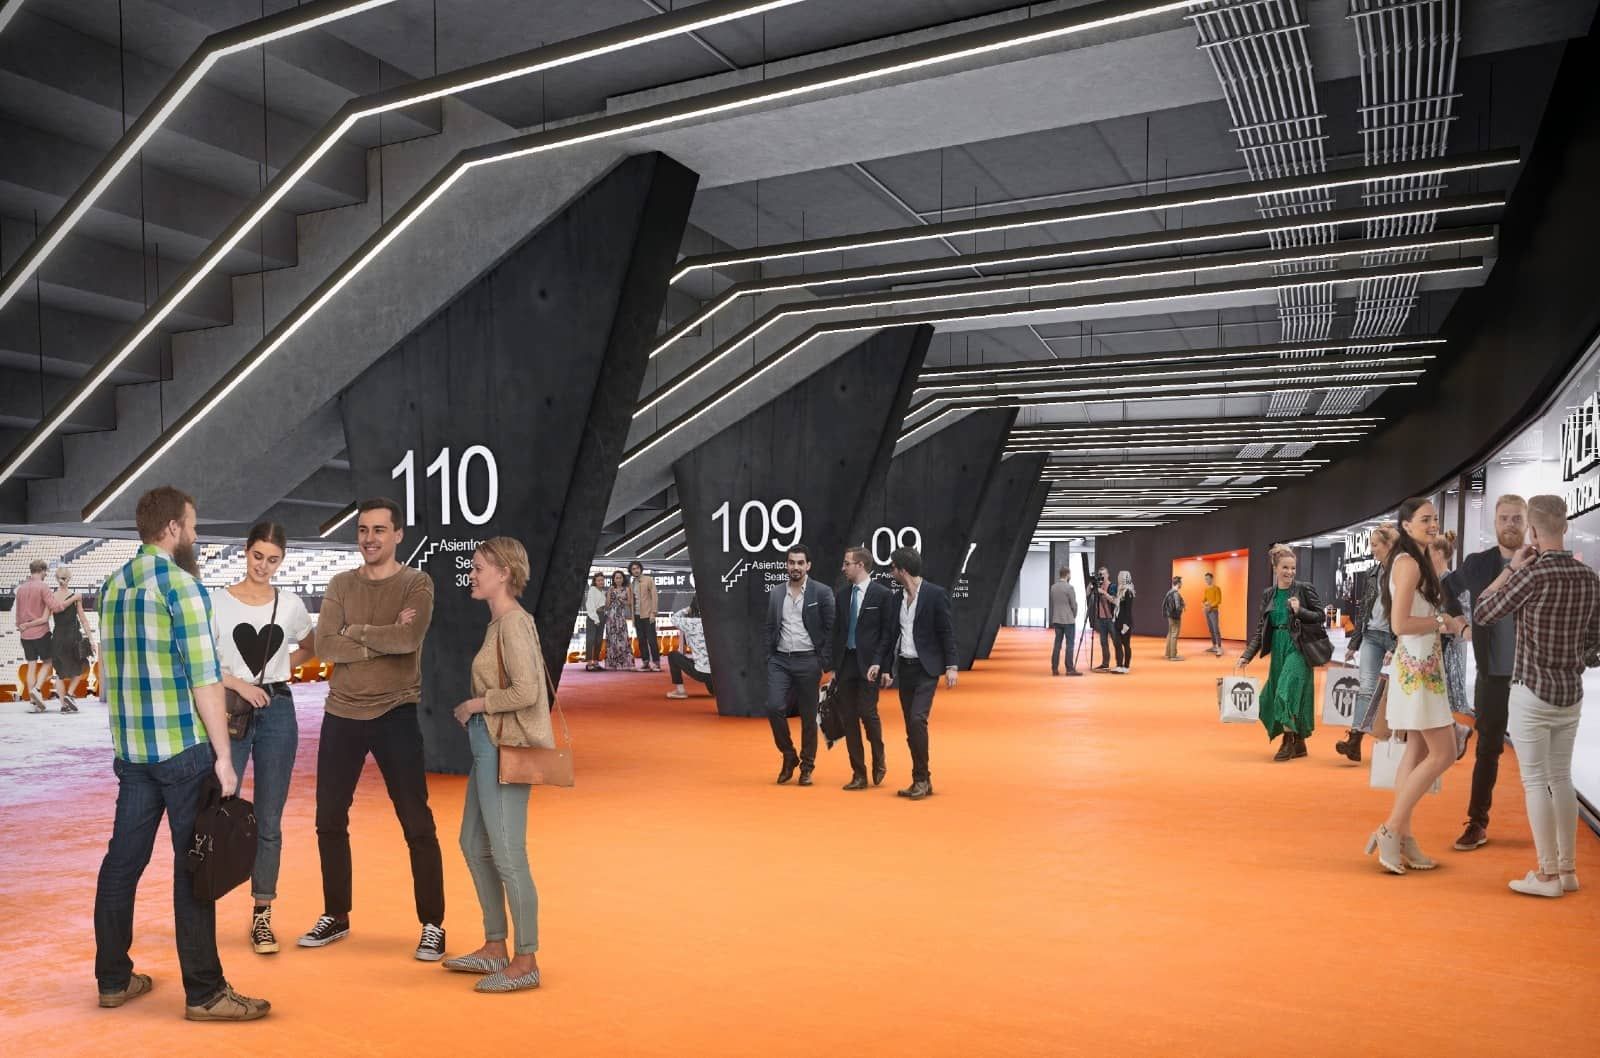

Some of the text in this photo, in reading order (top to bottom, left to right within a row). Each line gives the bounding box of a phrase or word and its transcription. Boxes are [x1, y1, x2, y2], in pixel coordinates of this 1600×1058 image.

[391, 444, 499, 527] 110
[711, 498, 803, 553] 109
[862, 526, 922, 566] 09
[455, 573, 473, 587] 30-
[764, 571, 790, 581] Seats
